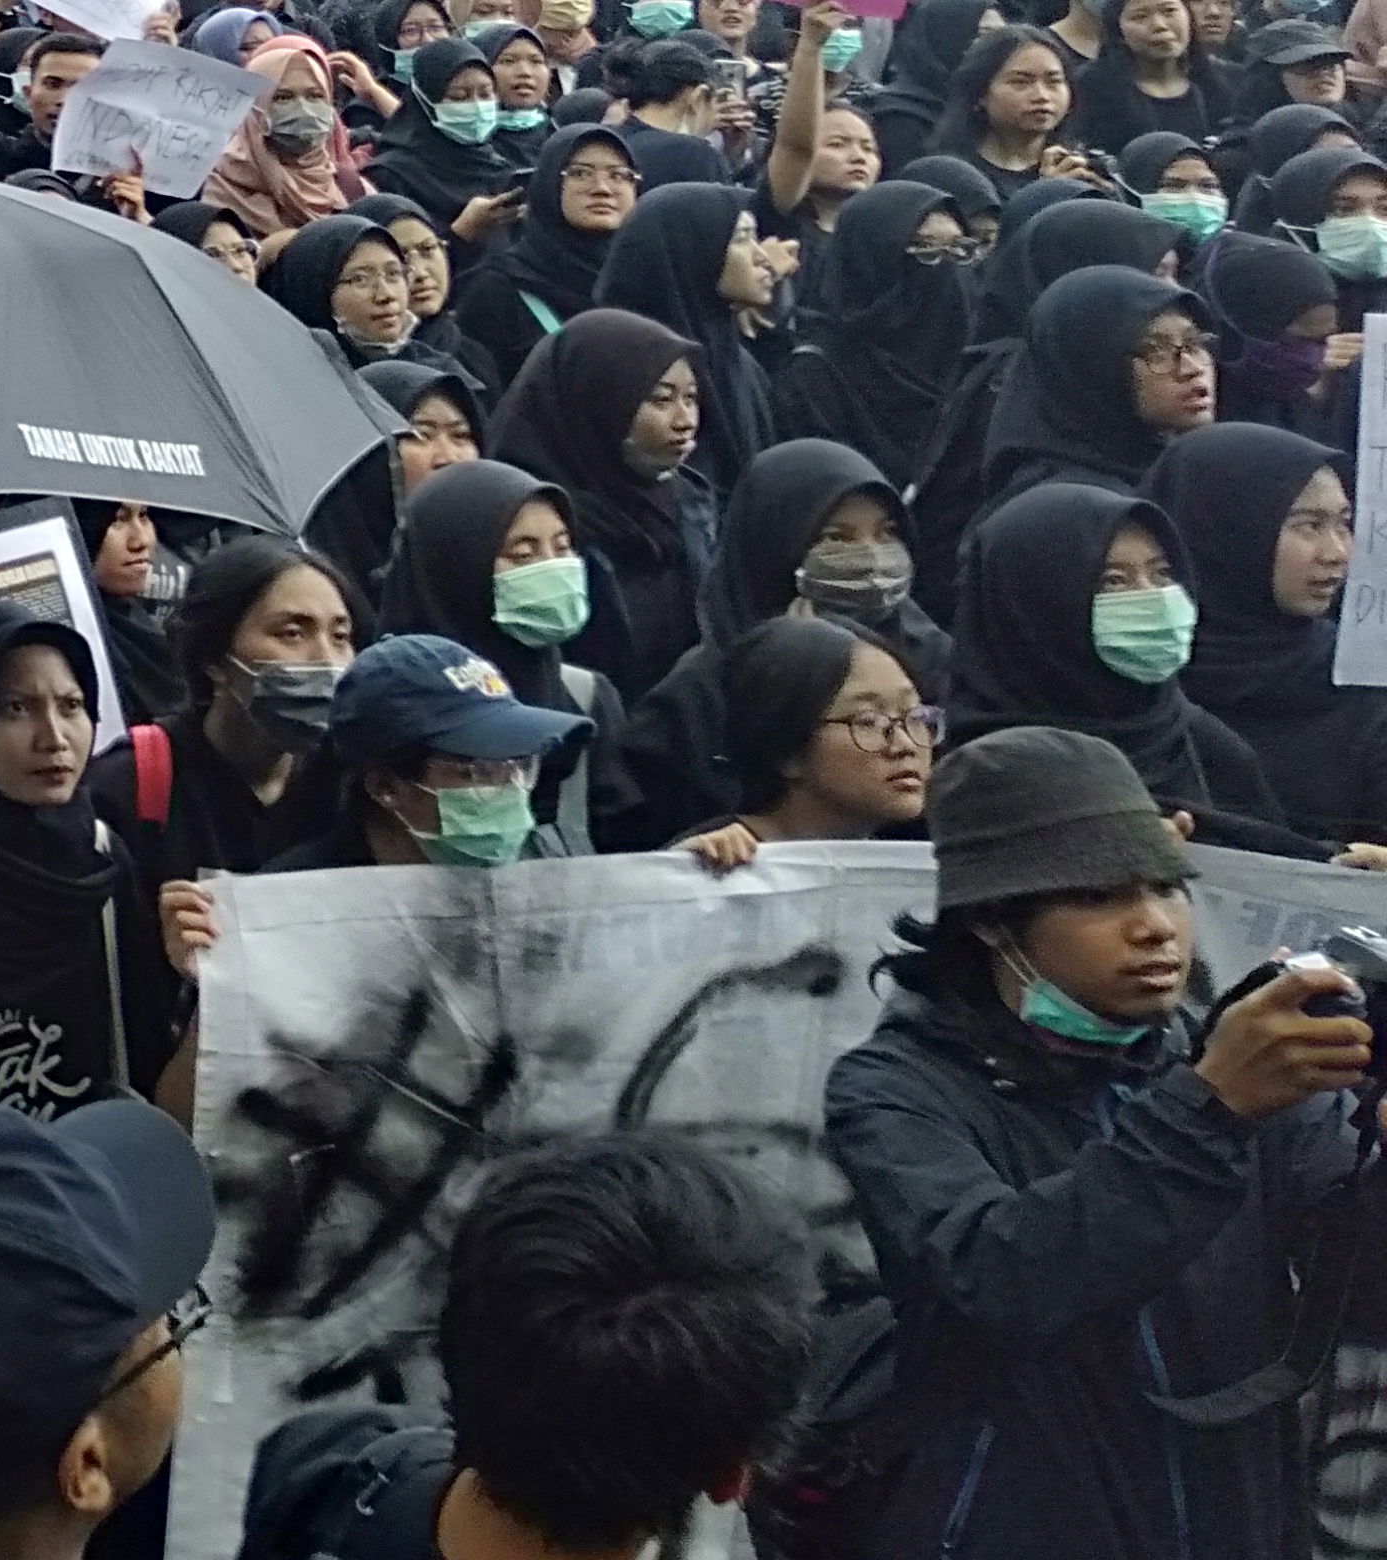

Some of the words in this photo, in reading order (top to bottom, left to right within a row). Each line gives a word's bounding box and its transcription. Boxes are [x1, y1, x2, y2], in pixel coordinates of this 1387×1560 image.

[17, 422, 84, 464] TANAH
[77, 431, 145, 472] UNTUK
[138, 439, 207, 477] RAKYAT
